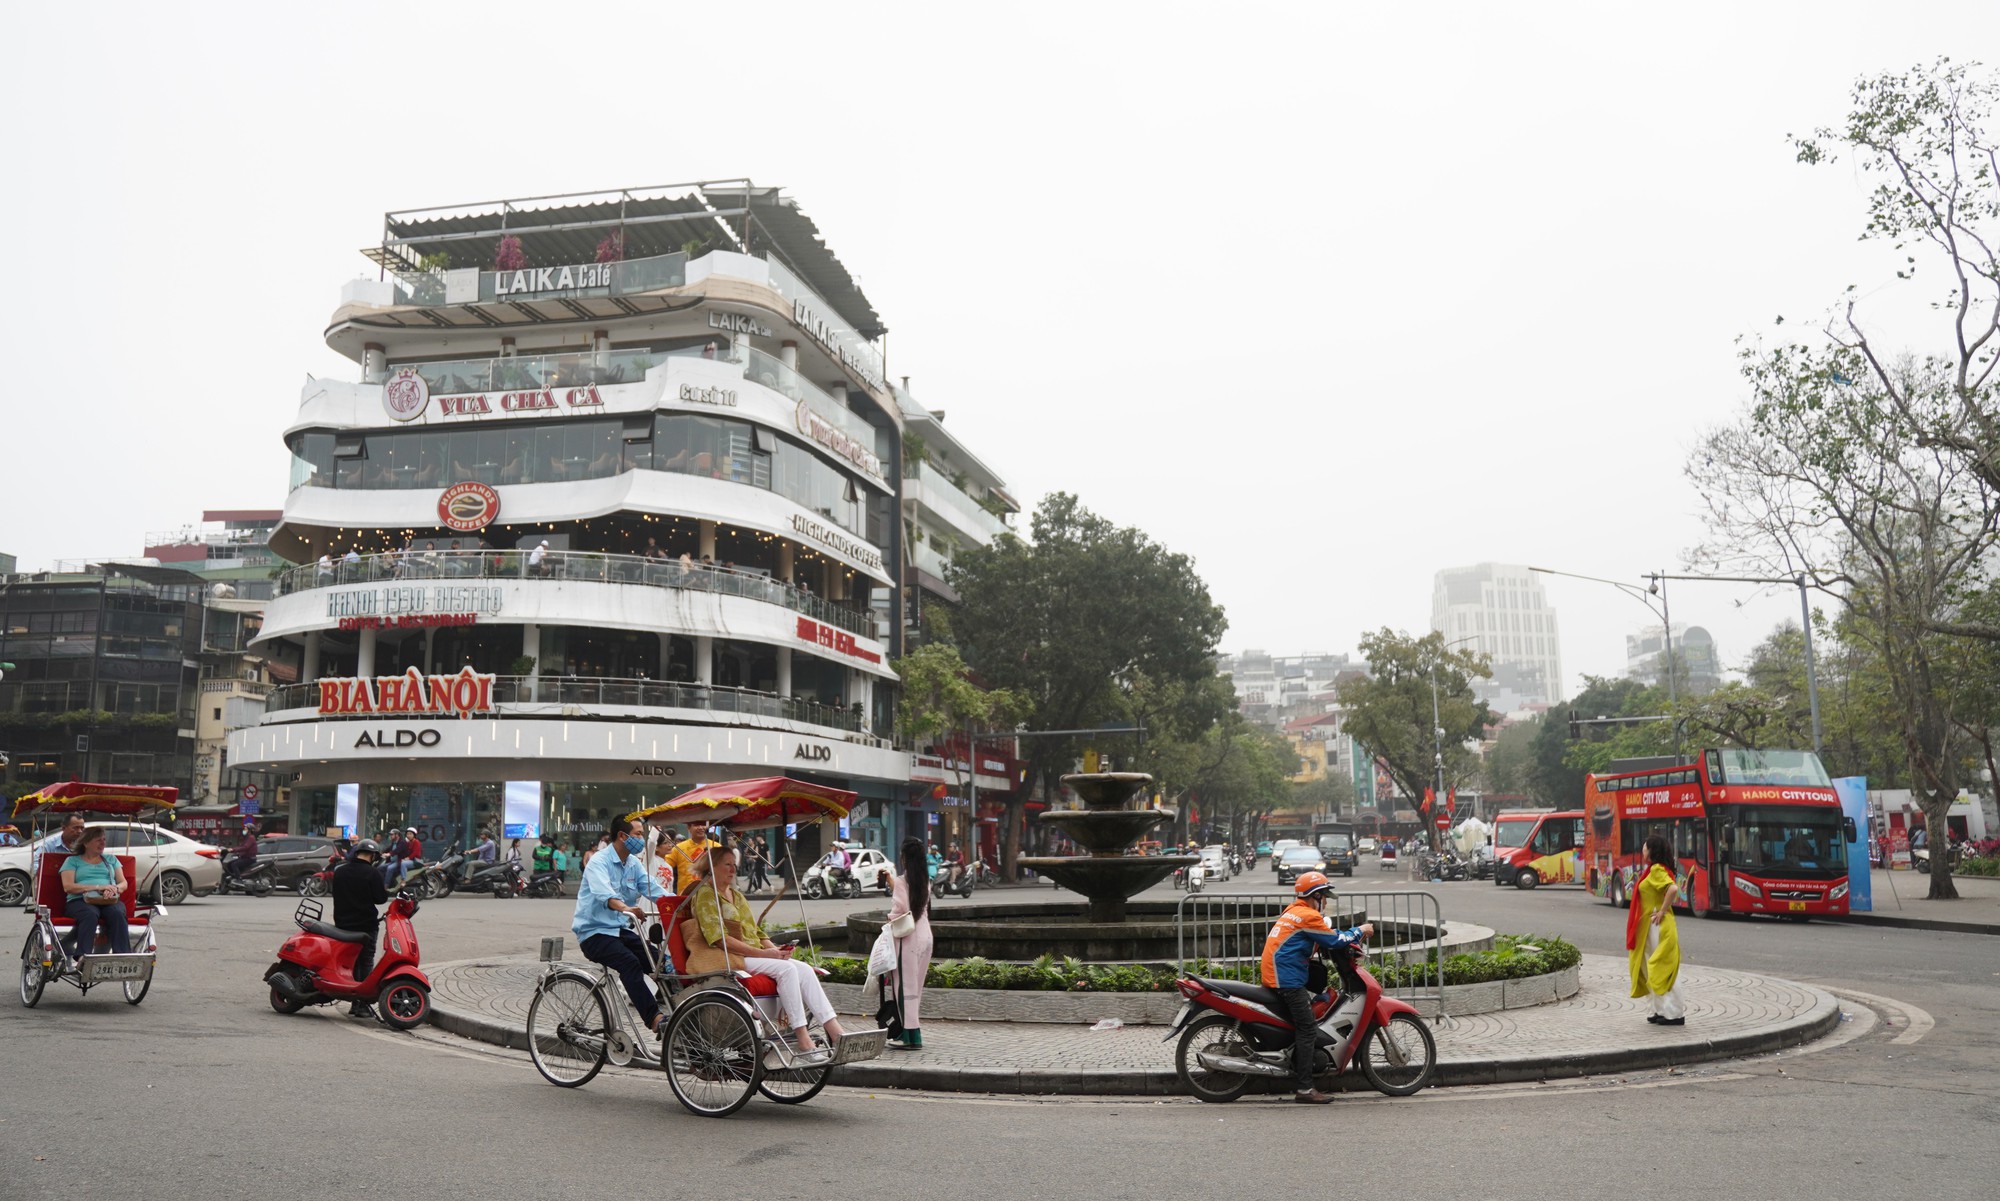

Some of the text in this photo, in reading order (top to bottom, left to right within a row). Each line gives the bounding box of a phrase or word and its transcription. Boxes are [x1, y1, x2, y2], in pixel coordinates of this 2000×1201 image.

[495, 265, 575, 295] LAIKA
[578, 264, 611, 288] Café
[708, 310, 759, 335] LAIKA
[794, 299, 827, 348] LAIKA
[438, 382, 604, 416] VUA CHẢ CÁ
[721, 389, 737, 407] 10
[441, 484, 495, 506] HIGHLANDS
[447, 515, 489, 529] COFFEE
[794, 514, 882, 571] HIGHLANDS COFFEE
[326, 586, 503, 617] HANOI 1930 BISTRO
[339, 615, 381, 631] COFFEE
[397, 612, 478, 629] RESTAURANT
[318, 667, 496, 721] BIA HÀ NỘI
[354, 728, 441, 748] ALDO
[794, 743, 832, 762] ALDO
[630, 766, 676, 777] ALDO
[1643, 792, 1655, 805] CITY
[1655, 790, 1670, 804] TOUR
[1742, 790, 1780, 800] HANOI
